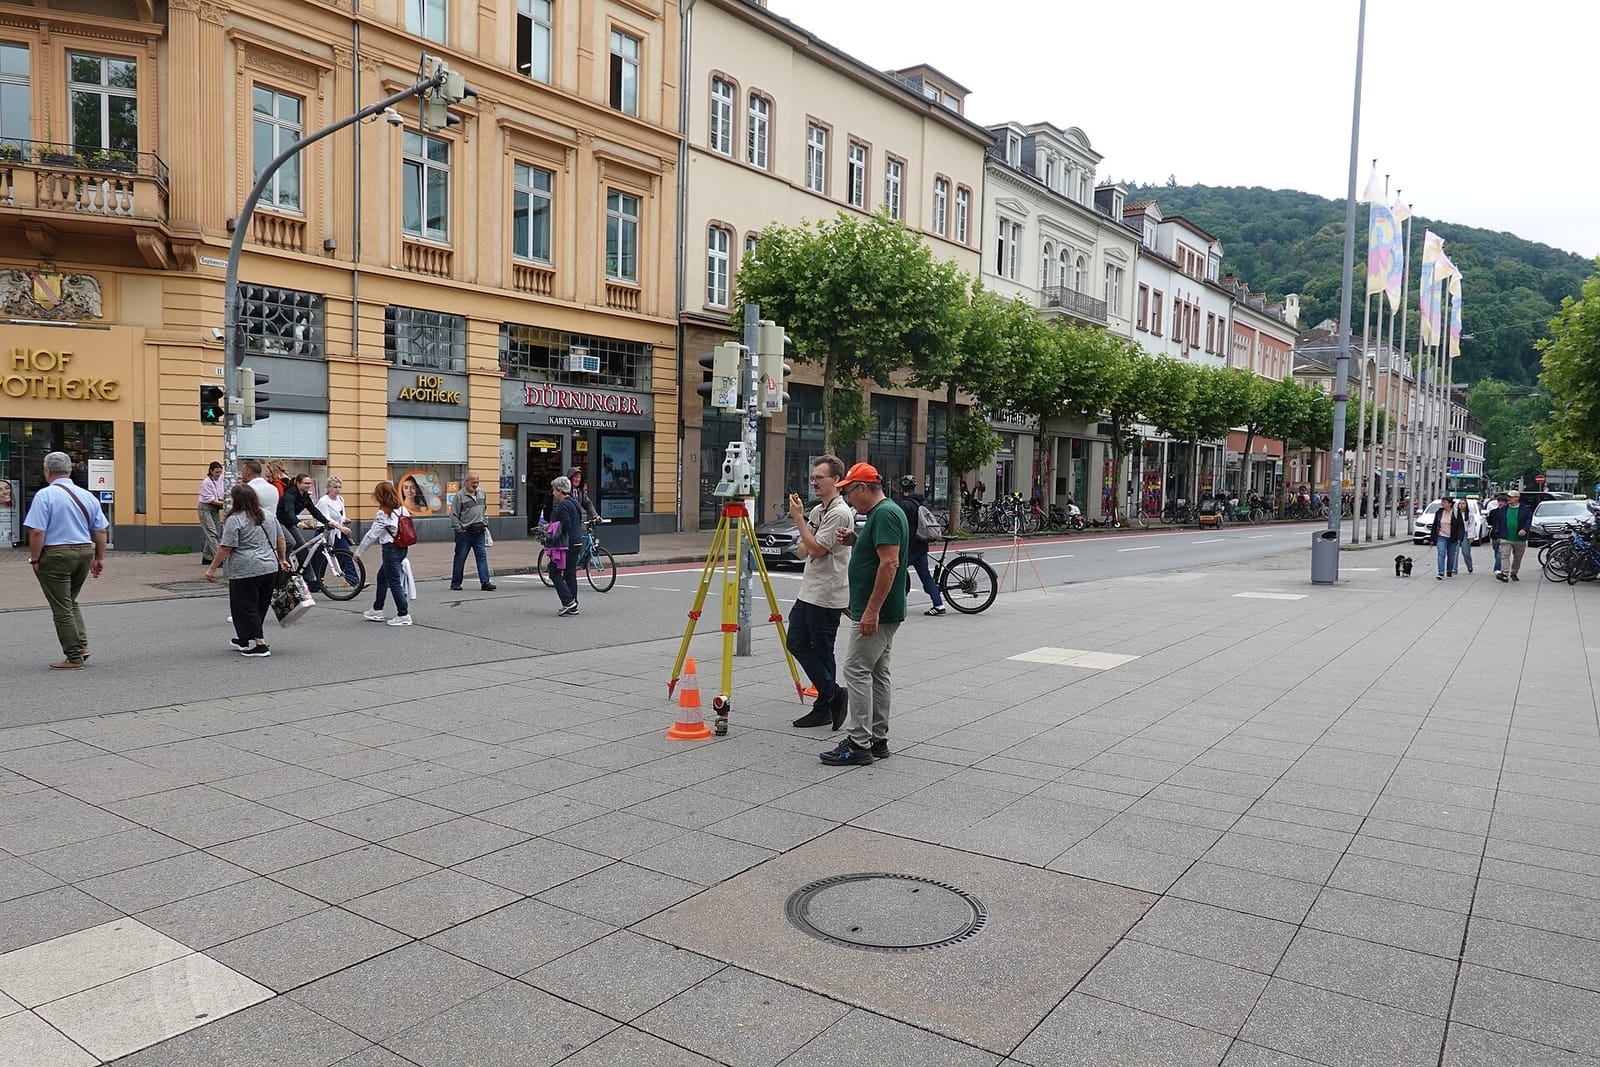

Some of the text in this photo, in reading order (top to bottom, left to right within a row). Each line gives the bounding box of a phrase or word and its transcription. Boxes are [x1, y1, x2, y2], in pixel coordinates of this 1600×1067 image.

[201, 256, 229, 267] Sophienstra
[11, 348, 73, 372] HOF
[417, 374, 443, 389] HOF
[399, 387, 462, 405] APOTHEKE
[549, 416, 618, 428] KARTENVORVERKAUF
[690, 453, 697, 463] 13
